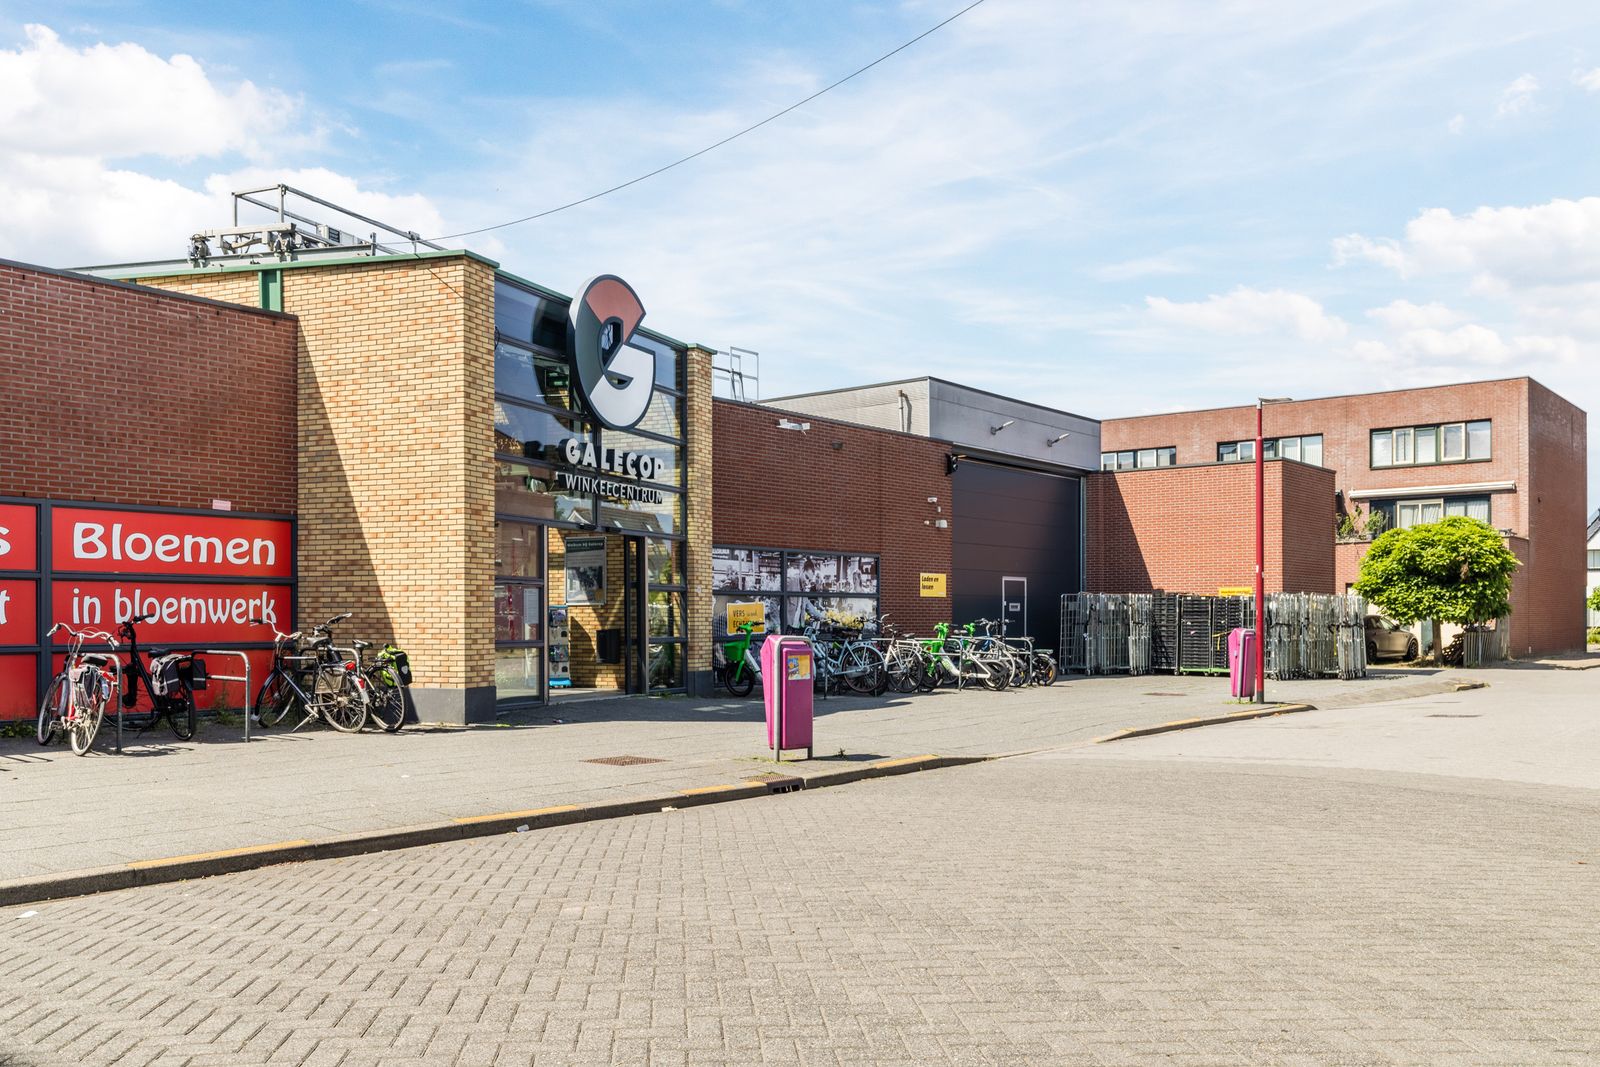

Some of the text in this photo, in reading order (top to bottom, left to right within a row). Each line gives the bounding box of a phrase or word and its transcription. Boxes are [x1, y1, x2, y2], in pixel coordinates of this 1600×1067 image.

[565, 437, 664, 480] GALECOP
[565, 473, 663, 504] WINKELCENTRUM
[73, 522, 276, 565] Bloemen
[73, 587, 277, 625] in bloemwerk
